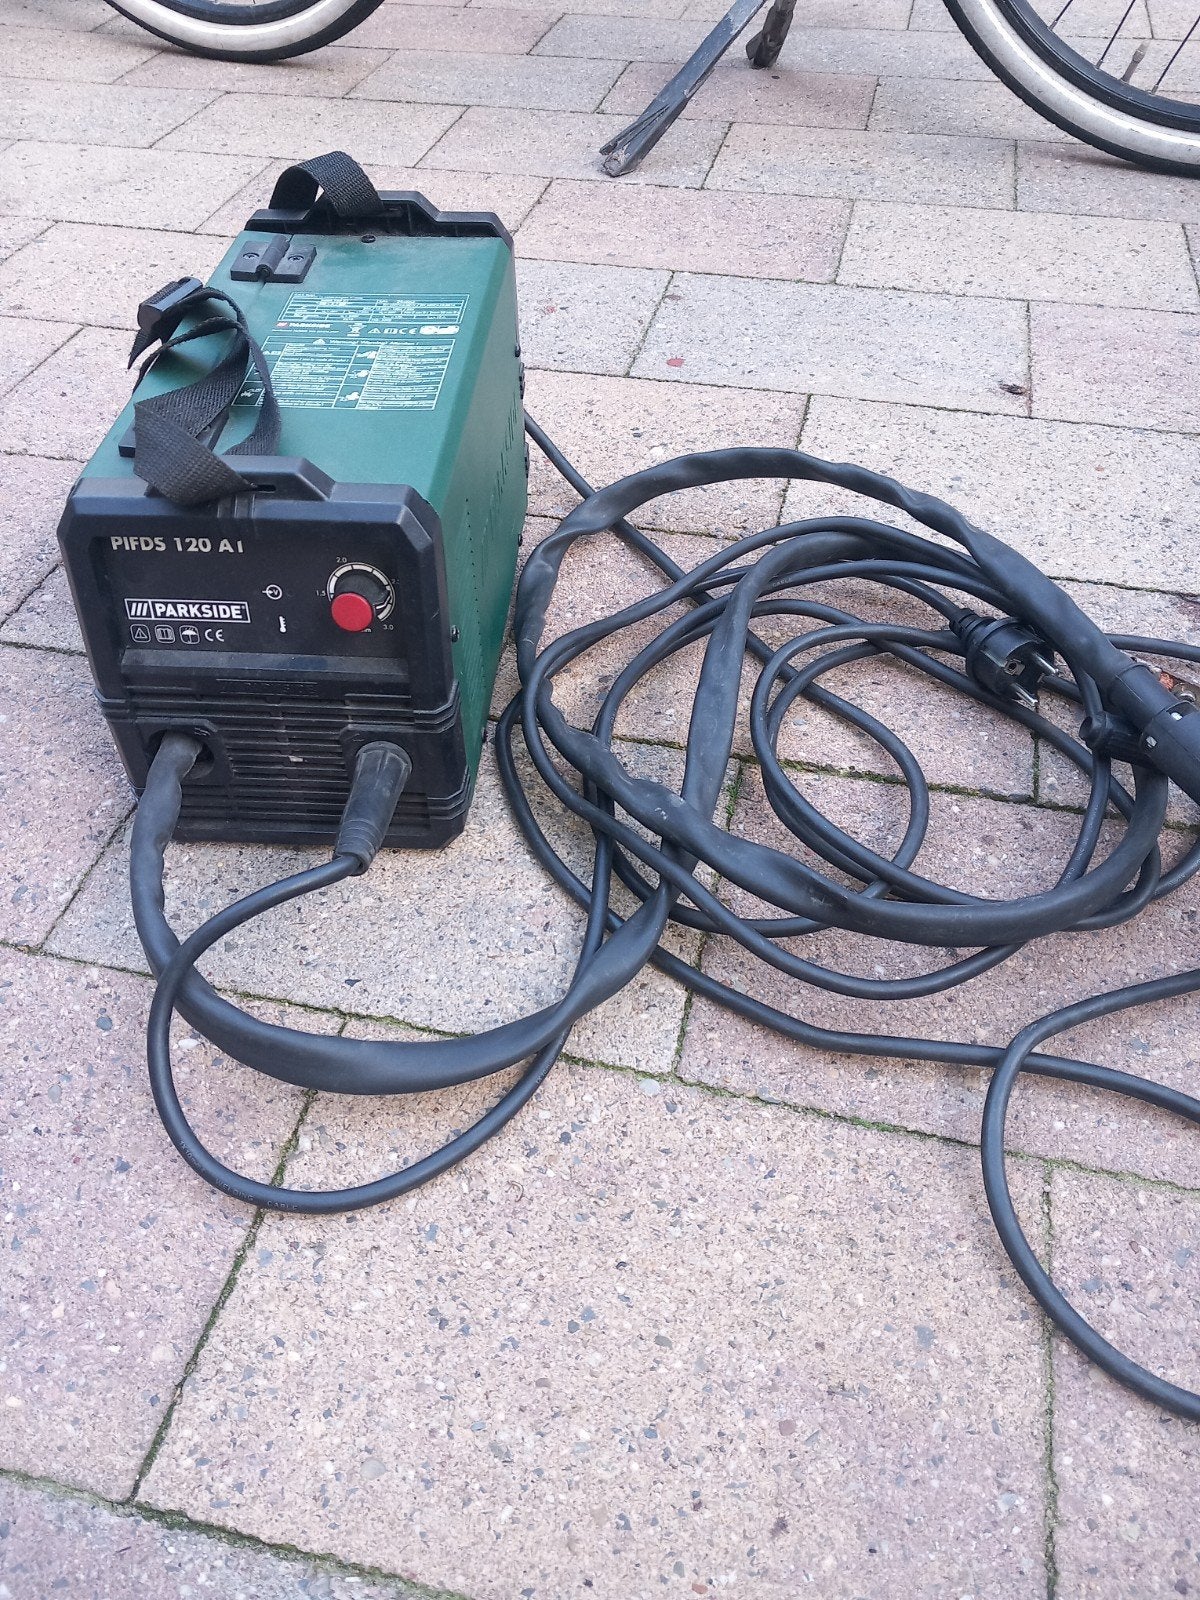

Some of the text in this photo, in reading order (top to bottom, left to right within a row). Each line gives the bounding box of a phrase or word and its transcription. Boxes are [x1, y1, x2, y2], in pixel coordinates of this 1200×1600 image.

[110, 536, 166, 551] PIFDS
[173, 537, 212, 553] 120
[154, 603, 243, 619] PARKSIDE
[204, 628, 225, 642] CE
